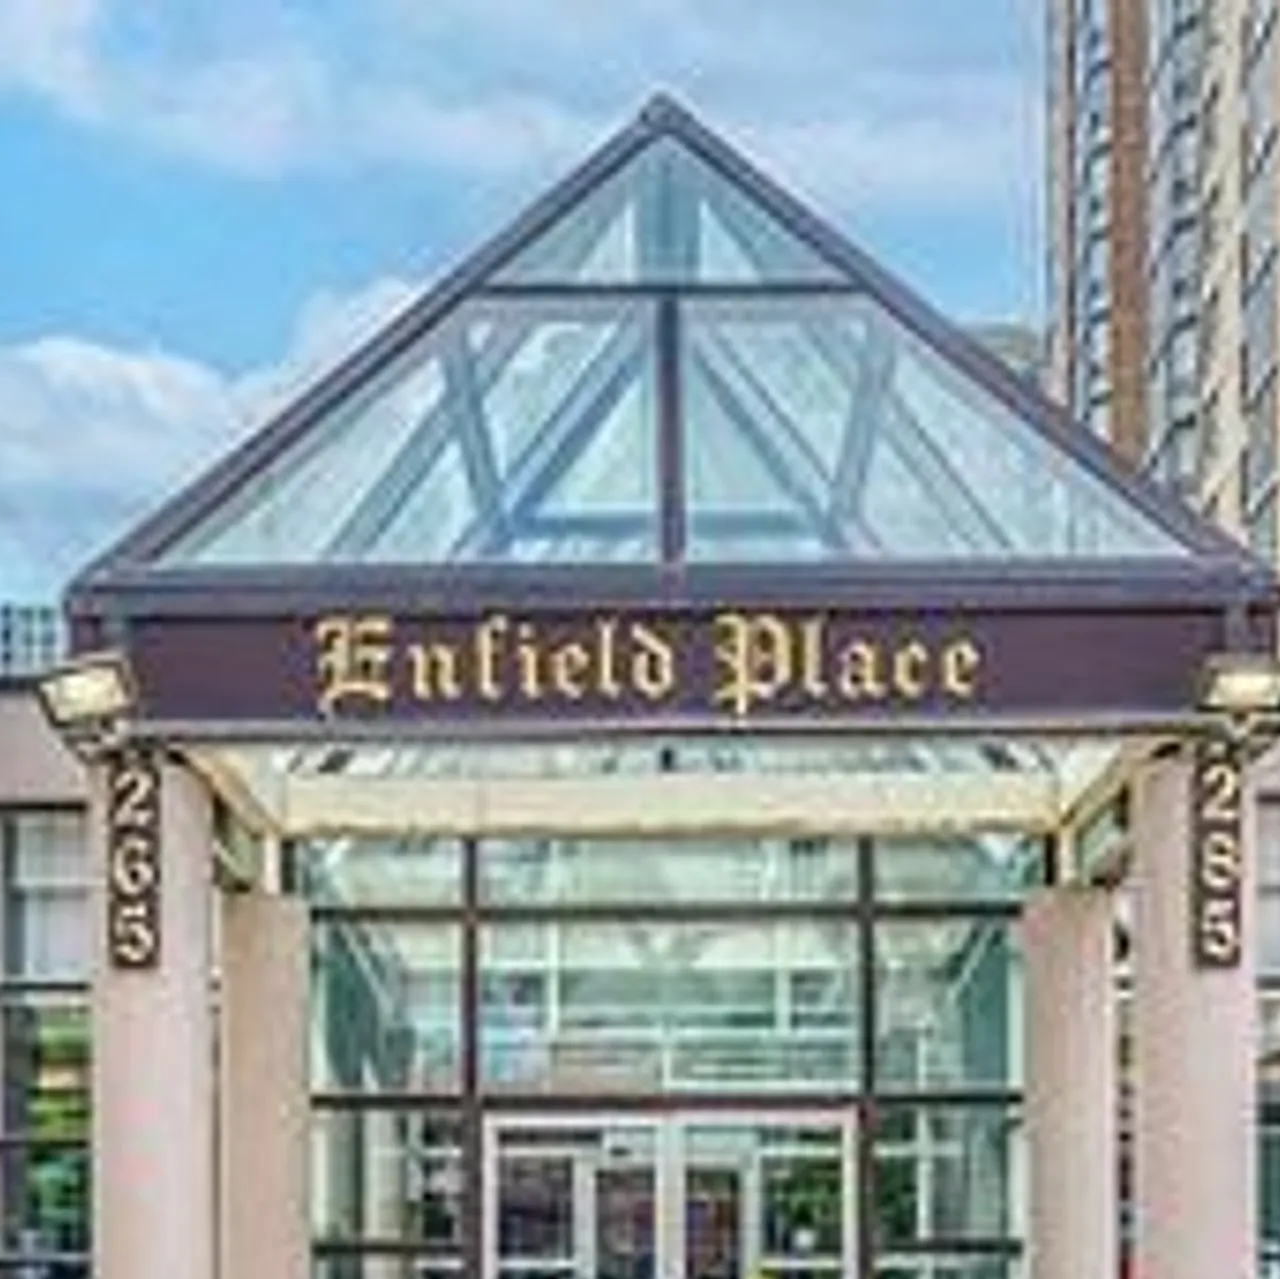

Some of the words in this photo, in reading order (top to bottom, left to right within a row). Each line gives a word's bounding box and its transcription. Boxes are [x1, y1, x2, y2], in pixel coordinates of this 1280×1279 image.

[317, 613, 674, 706] Enfield
[717, 613, 981, 714] Place
[113, 769, 155, 962] 265
[1201, 763, 1238, 961] 285
